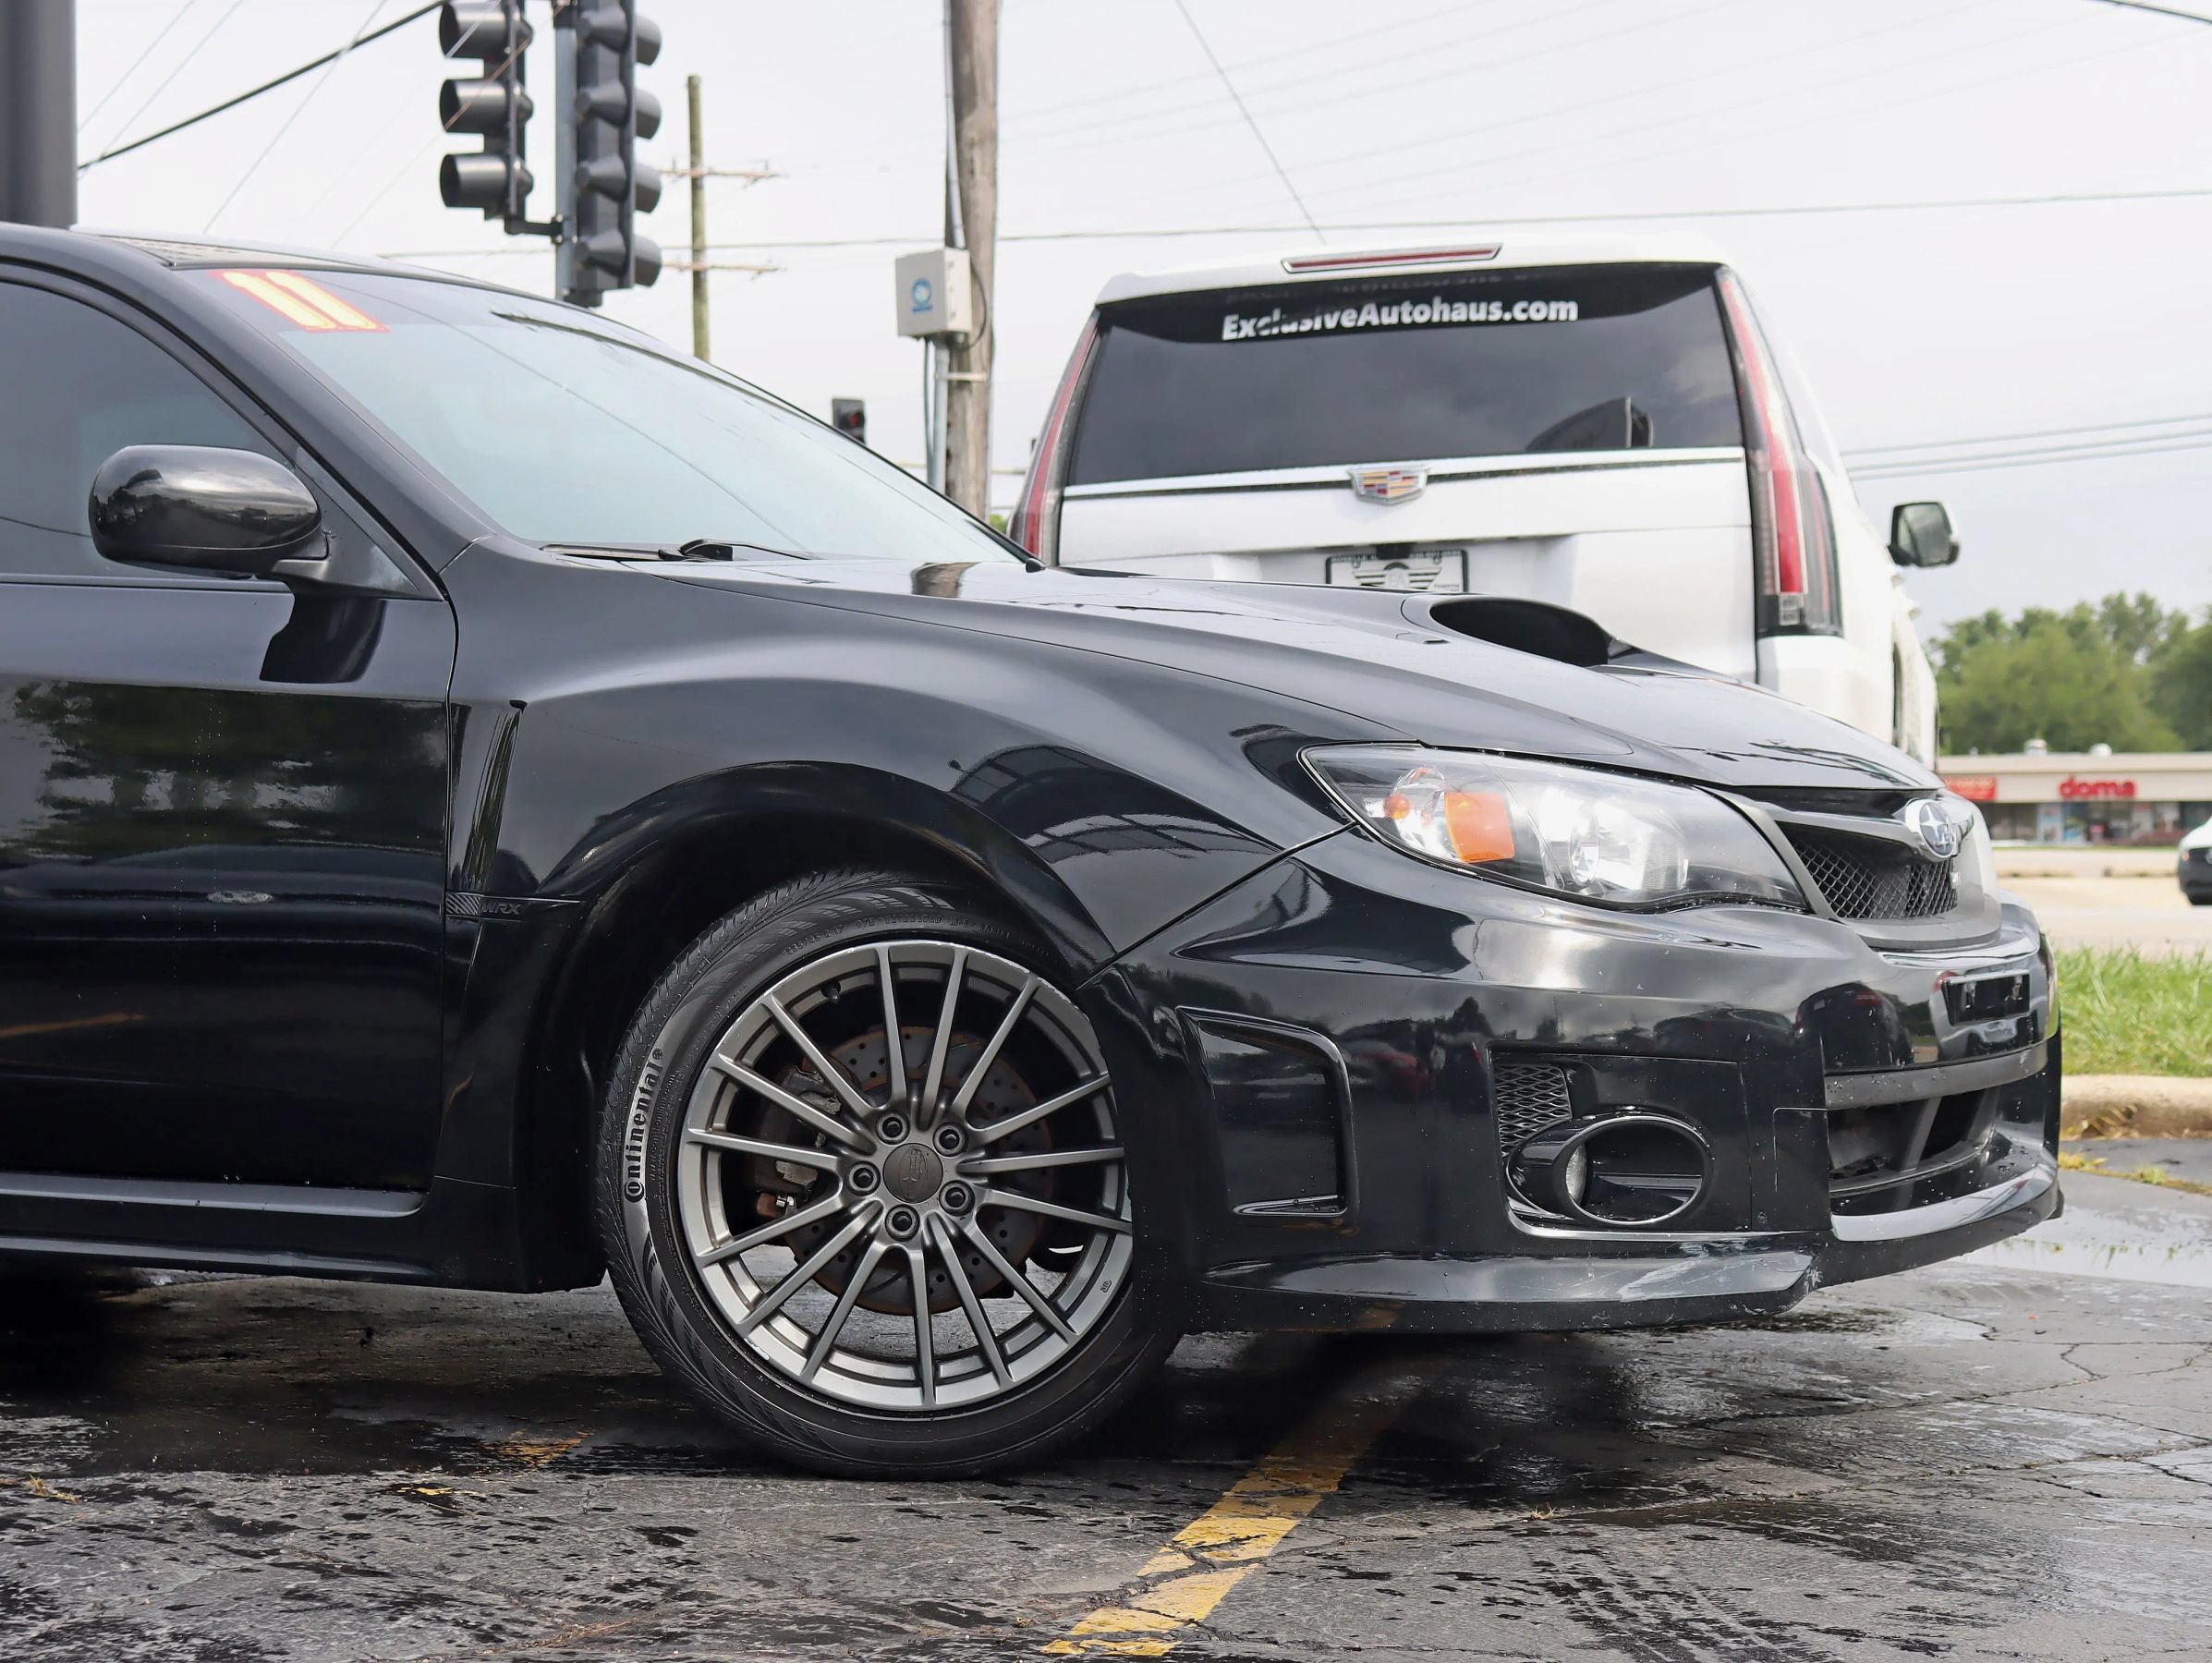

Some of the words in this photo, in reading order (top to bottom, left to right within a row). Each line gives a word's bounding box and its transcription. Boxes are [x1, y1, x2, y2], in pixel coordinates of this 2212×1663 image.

[213, 271, 384, 331] 11
[1221, 296, 1579, 341] ExclusiveAutohaus.com
[481, 902, 520, 915] WRX
[624, 1061, 664, 1203] Continental
